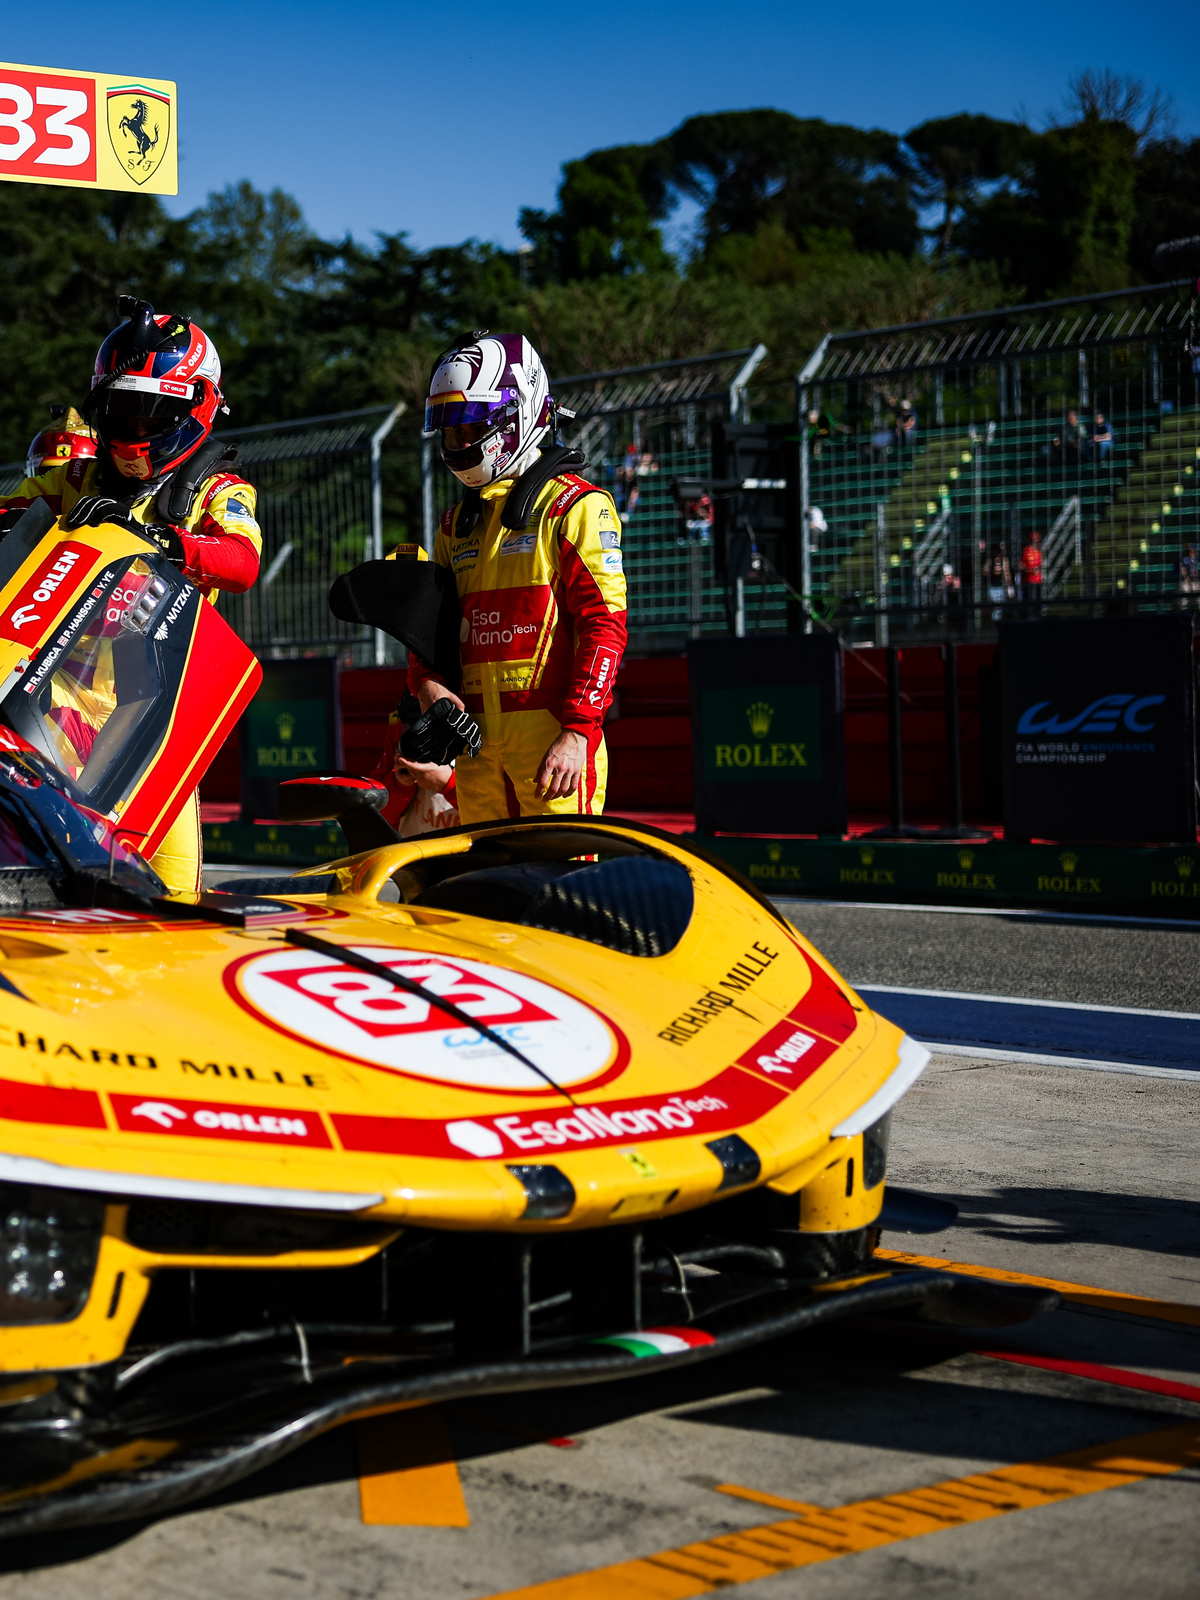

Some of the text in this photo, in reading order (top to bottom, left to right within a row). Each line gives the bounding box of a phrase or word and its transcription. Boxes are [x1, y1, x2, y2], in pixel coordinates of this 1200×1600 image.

[188, 342, 204, 367] ORLEN
[171, 385, 185, 393] ORLEN
[488, 442, 501, 454] BELL
[556, 484, 581, 509] Sabelt
[502, 535, 537, 548] WEC
[32, 550, 81, 603] ORLEN
[167, 583, 194, 626] NATZKA
[30, 570, 116, 686] R.KUBICA P.HANSON Y.YE
[472, 608, 500, 627] Esa
[596, 656, 611, 690] ORLEN
[1016, 693, 1167, 735] WEC
[256, 745, 318, 768] ROLEX
[715, 743, 808, 768] ROLEX
[1015, 752, 1107, 765] CHAMPIONSHIP
[1016, 742, 1156, 753] FIA WORLD ENDURANCE
[749, 863, 802, 882] ROLEX
[840, 867, 896, 886] ROLEX
[937, 871, 997, 891] ROLEX
[1038, 875, 1102, 895] ROLEX
[1150, 879, 1200, 899] ROLE
[297, 956, 524, 1026] 83
[657, 940, 780, 1048] RICHARD MILLE
[783, 1031, 818, 1065] ORLEN
[179, 1059, 333, 1091] MILLE
[193, 1109, 308, 1137] ORLEN
